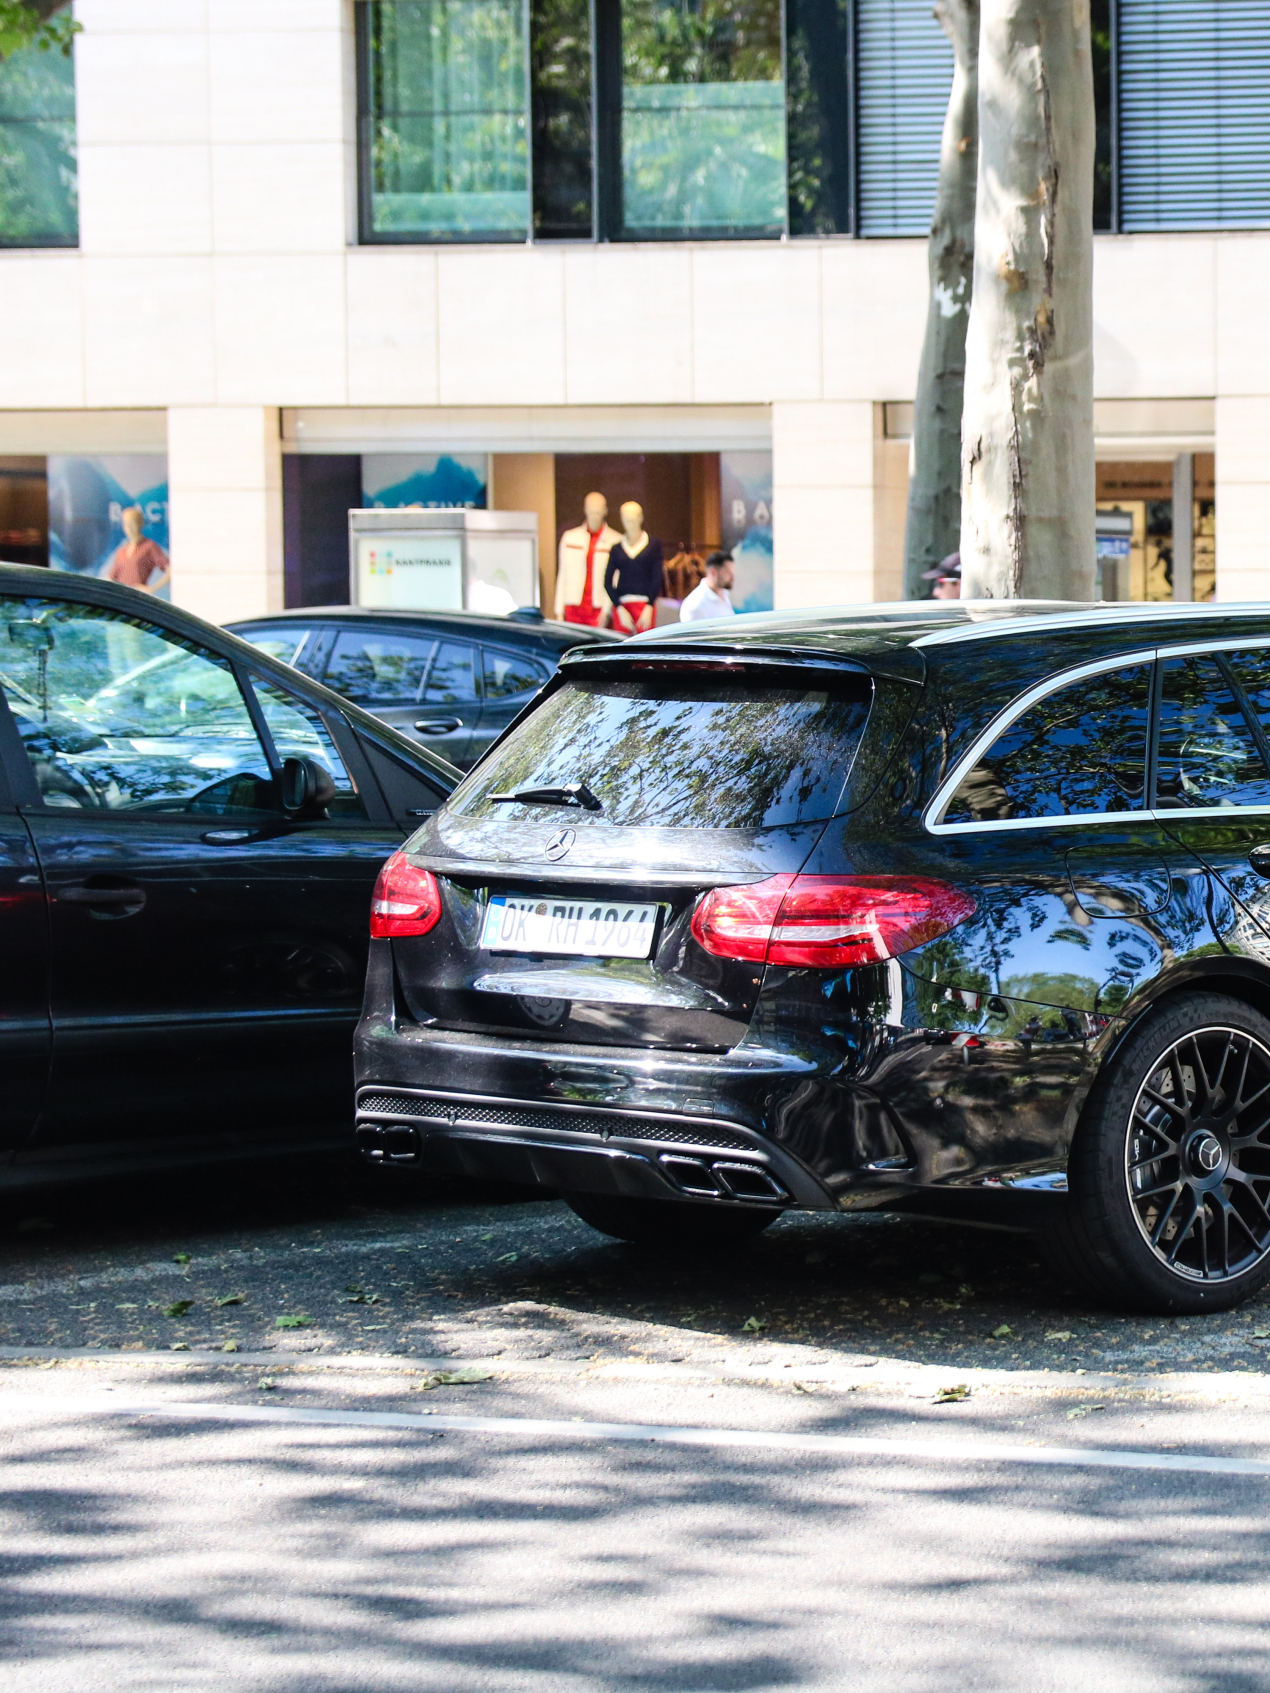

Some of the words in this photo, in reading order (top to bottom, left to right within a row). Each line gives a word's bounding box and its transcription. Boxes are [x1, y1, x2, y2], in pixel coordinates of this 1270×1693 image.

[548, 905, 584, 945] RH
[584, 906, 650, 949] 1964
[1131, 1016, 1181, 1075] MICHELIN
